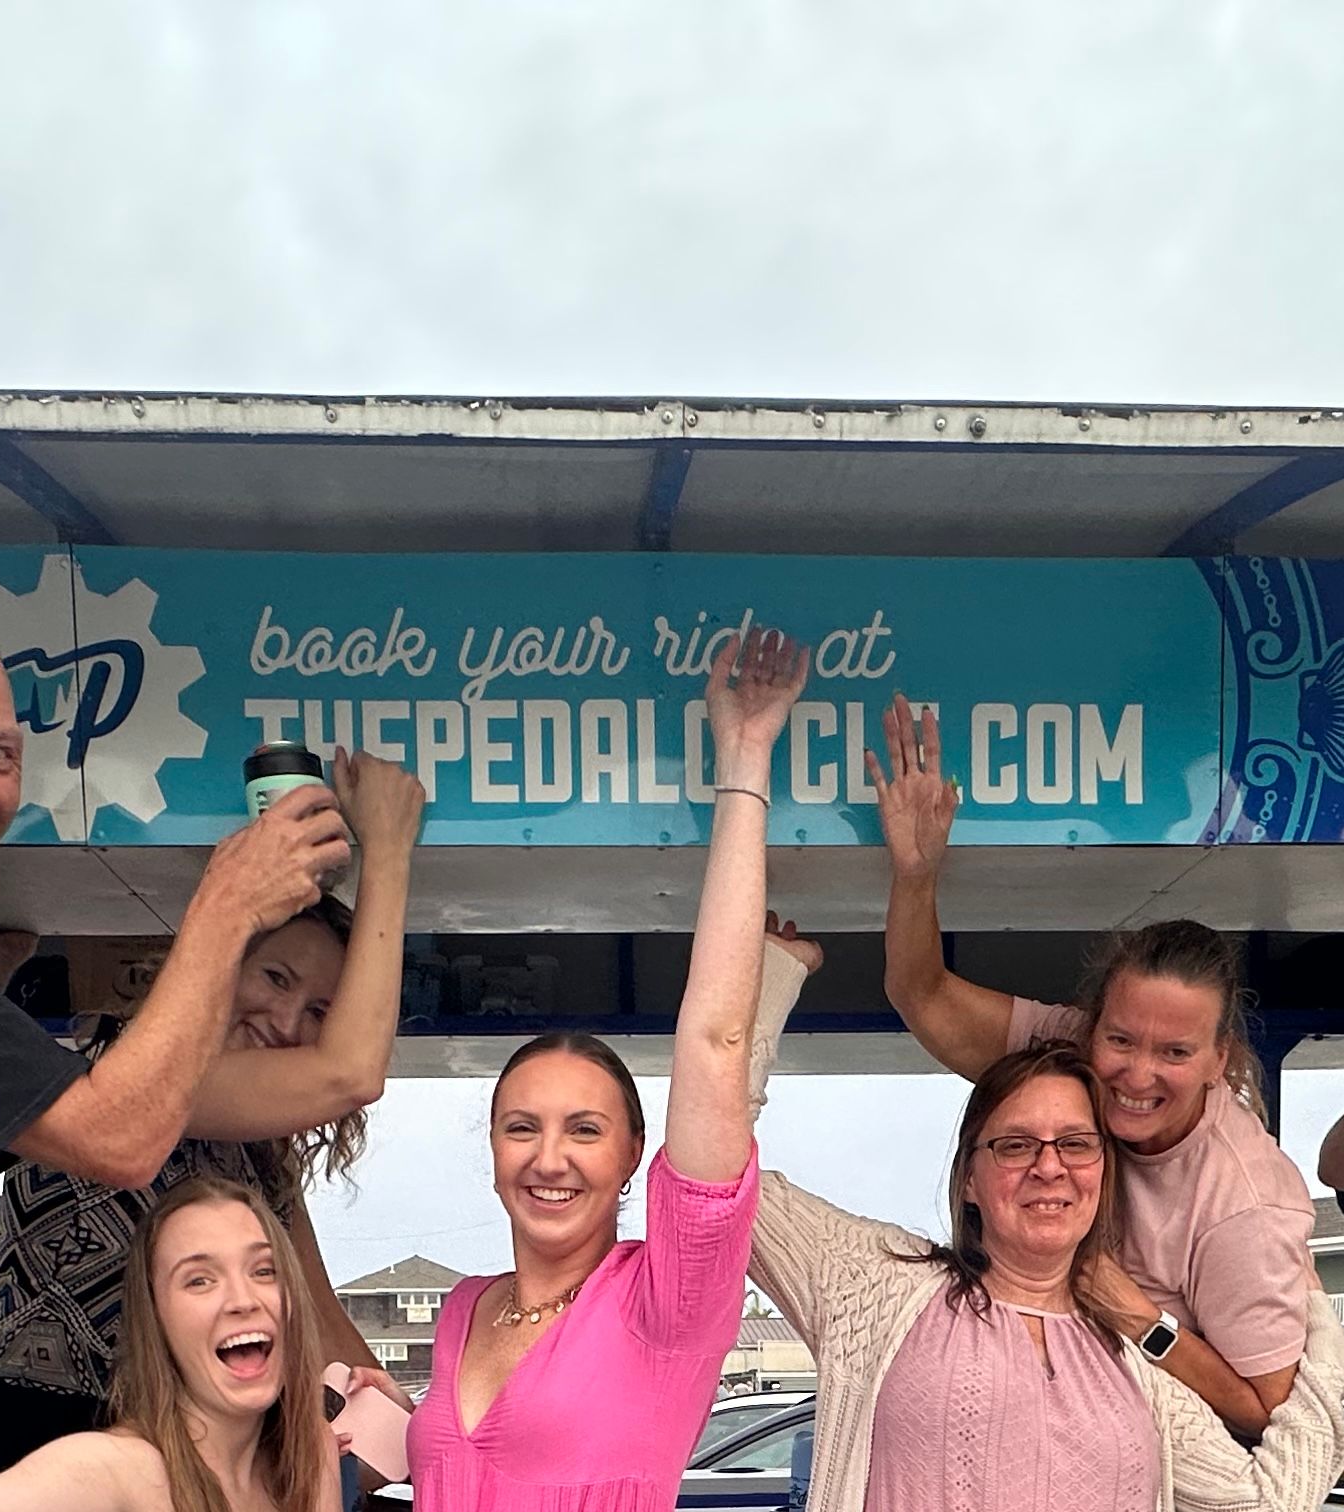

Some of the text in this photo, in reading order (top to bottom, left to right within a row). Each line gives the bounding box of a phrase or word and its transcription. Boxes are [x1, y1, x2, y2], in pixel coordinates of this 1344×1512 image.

[251, 605, 437, 676] book
[458, 615, 630, 706] your
[815, 610, 897, 679] at
